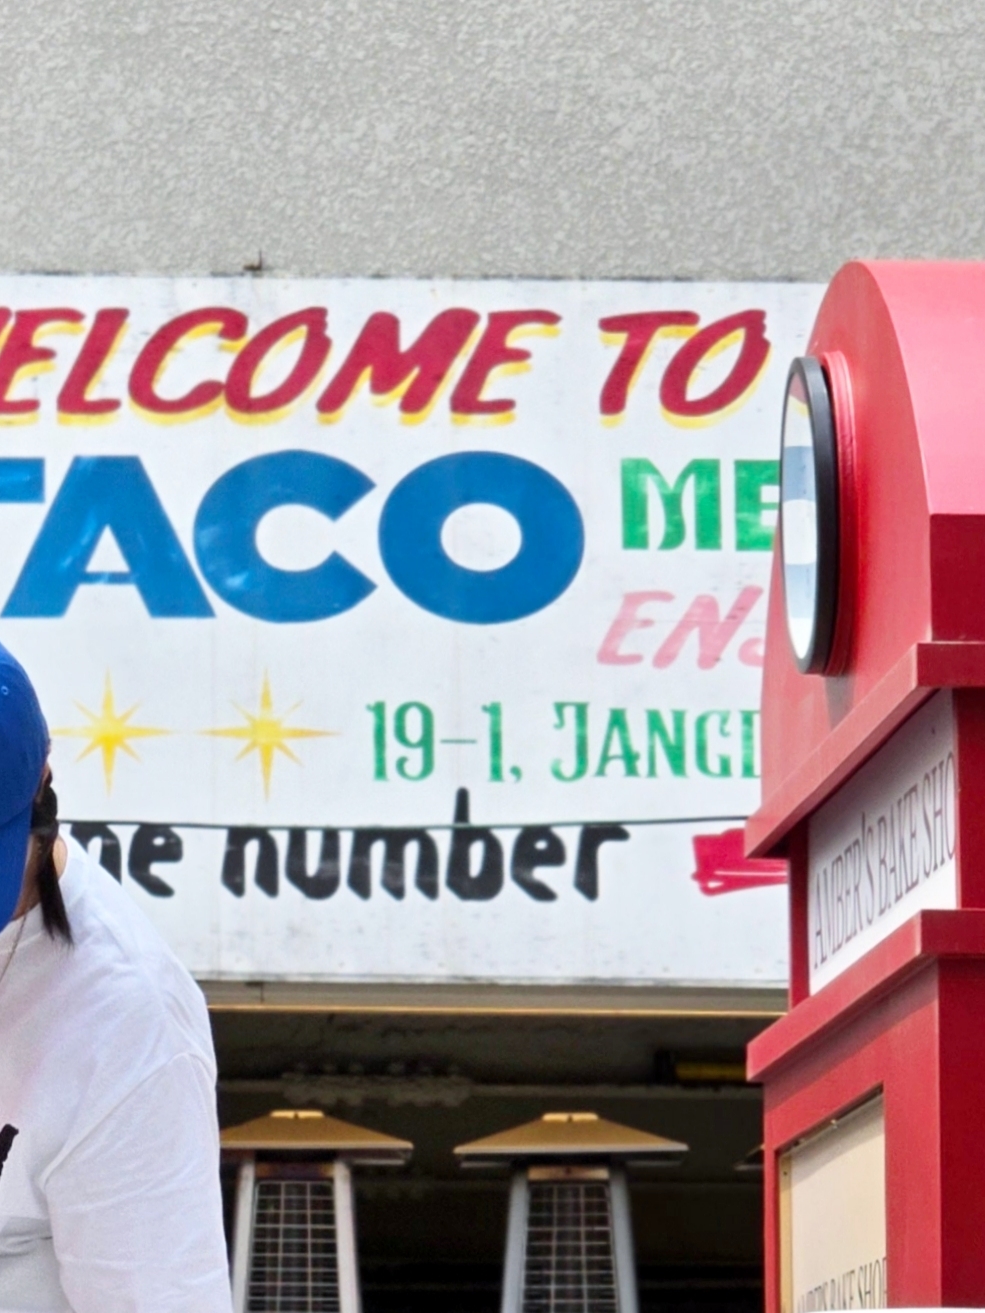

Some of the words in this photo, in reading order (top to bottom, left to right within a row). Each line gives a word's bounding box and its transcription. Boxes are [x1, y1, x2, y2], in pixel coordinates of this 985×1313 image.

[598, 308, 773, 430] TO
[221, 787, 630, 901] number
[877, 784, 920, 917] BAKE
